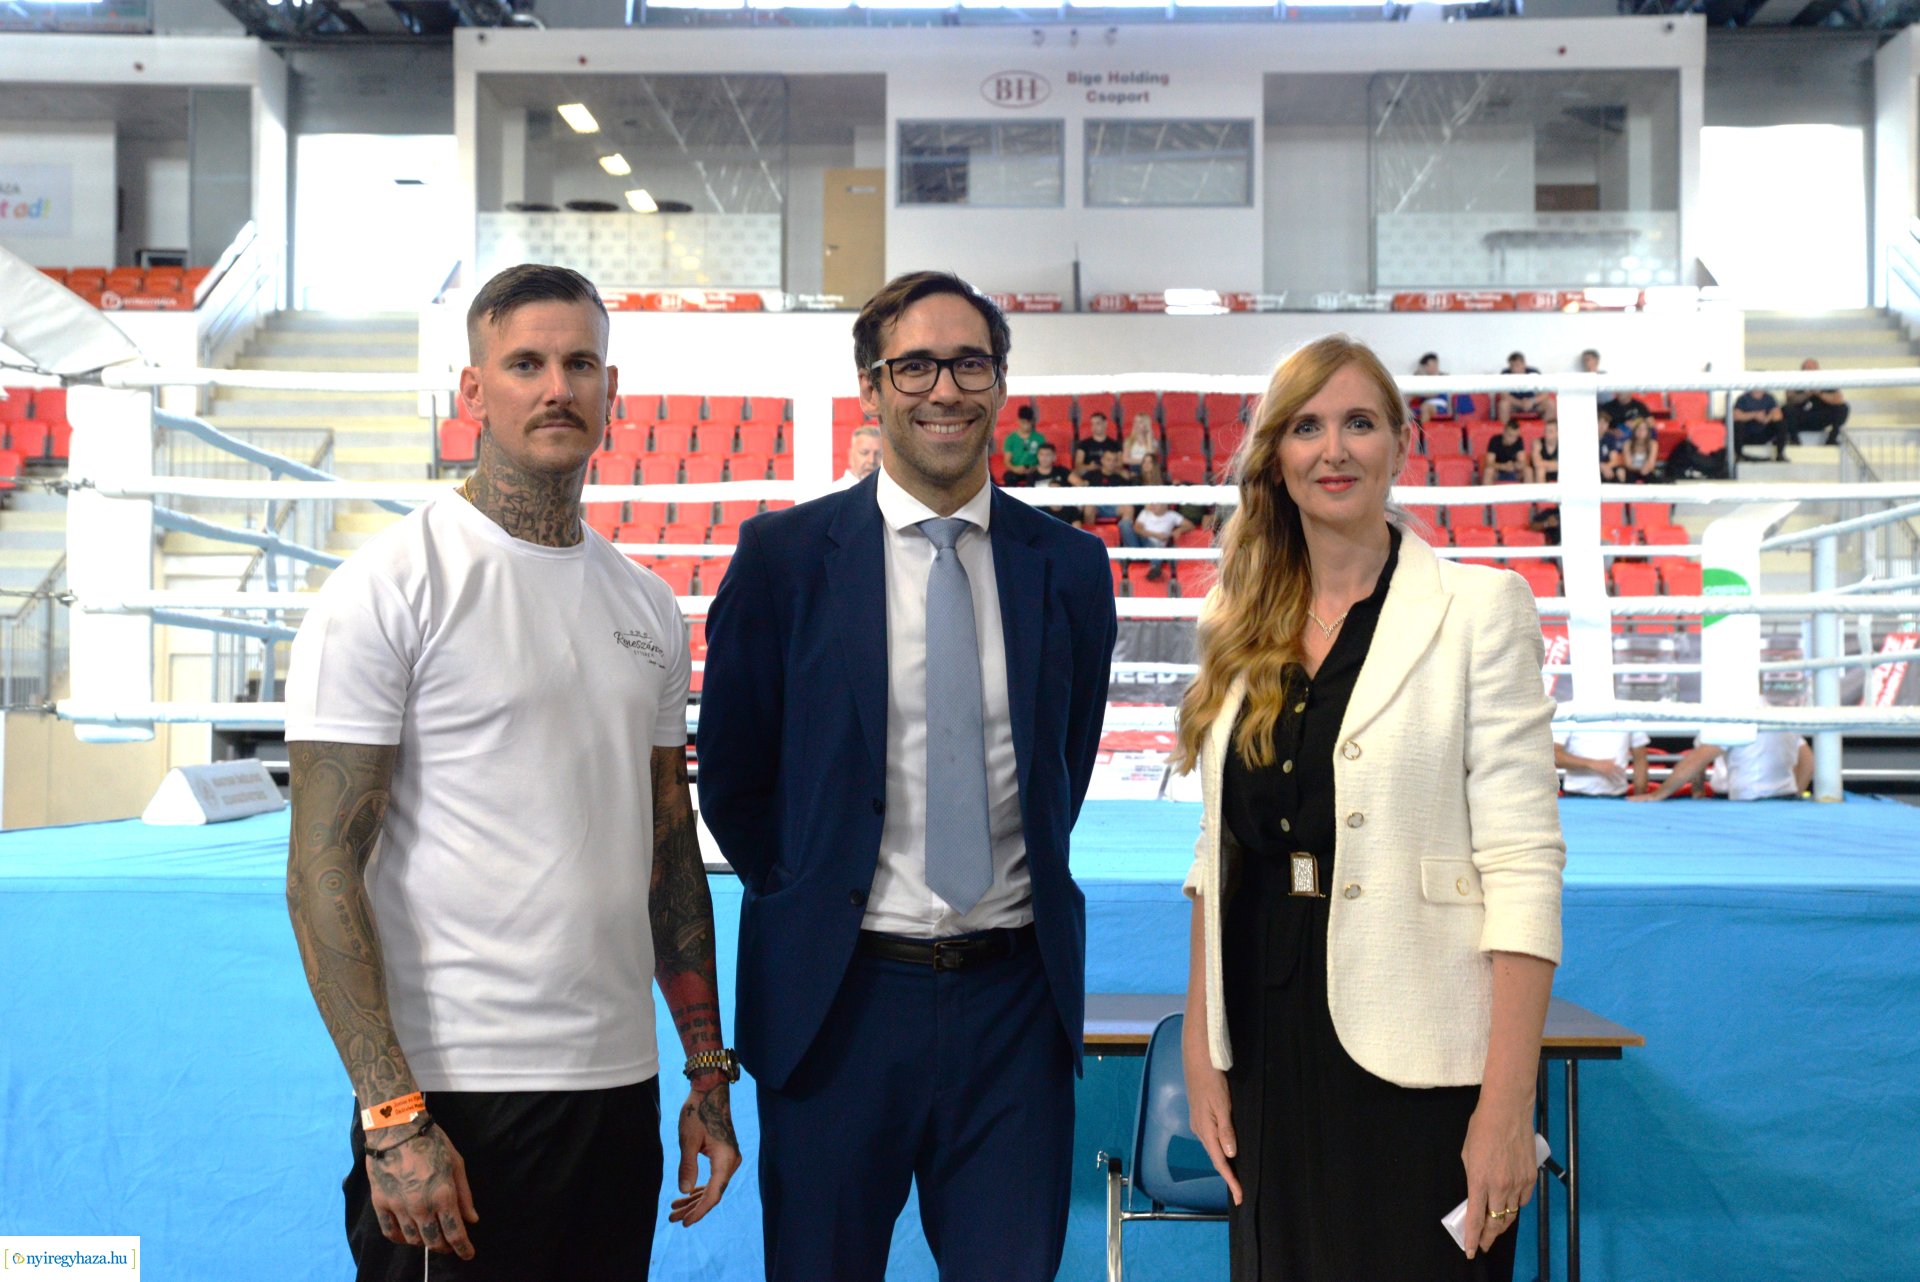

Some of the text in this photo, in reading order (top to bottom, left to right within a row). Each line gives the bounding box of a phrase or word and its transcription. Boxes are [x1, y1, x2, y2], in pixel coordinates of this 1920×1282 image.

[1066, 70, 1169, 86] Bige Holding
[995, 77, 1038, 101] BH
[1086, 89, 1150, 104] Csoport
